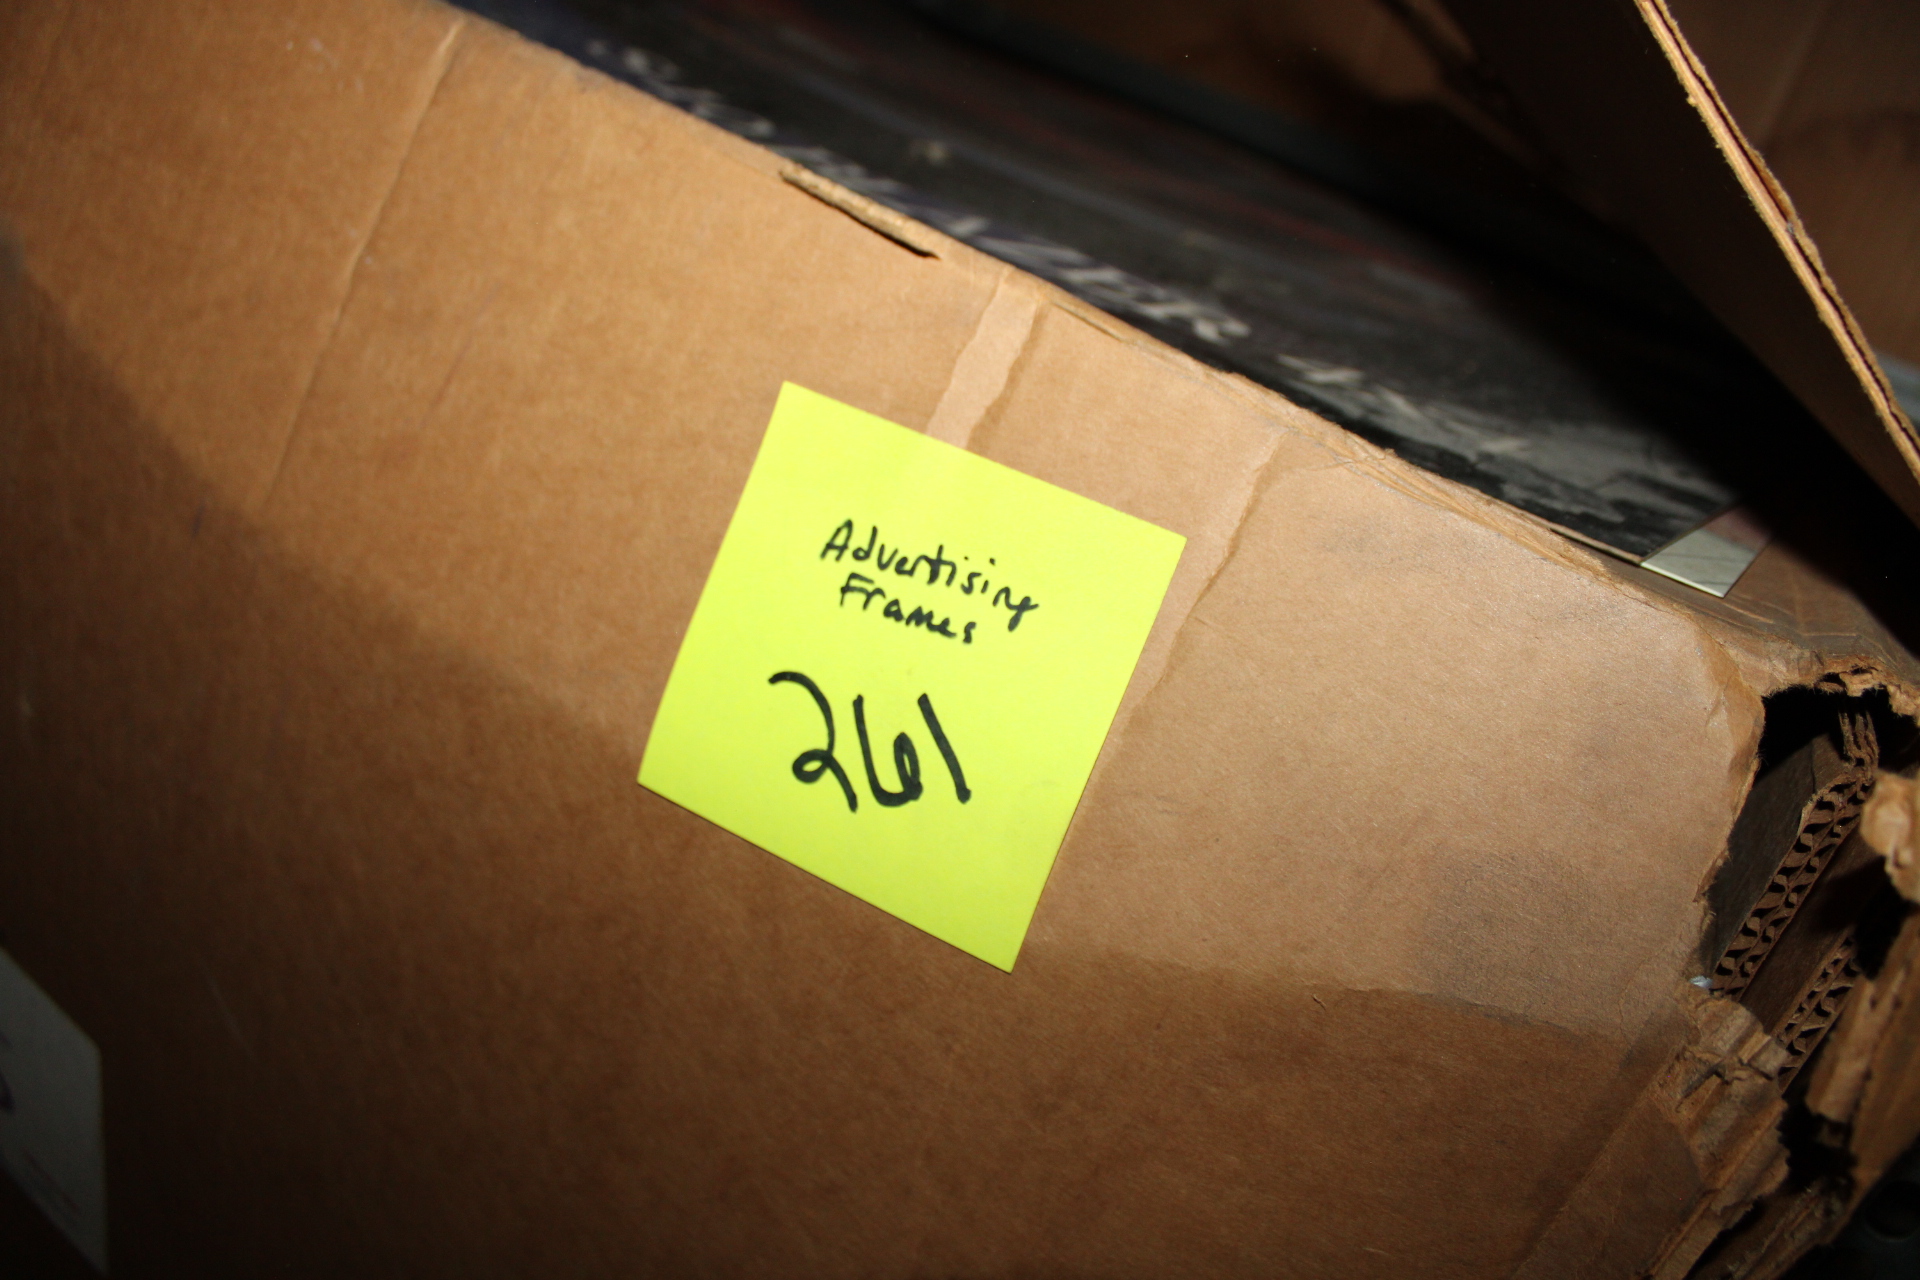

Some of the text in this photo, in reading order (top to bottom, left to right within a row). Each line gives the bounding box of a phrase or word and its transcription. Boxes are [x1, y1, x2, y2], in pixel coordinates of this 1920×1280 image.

[820, 519, 1040, 632] Advertising
[840, 572, 976, 645] Frames
[768, 671, 972, 813] 261
